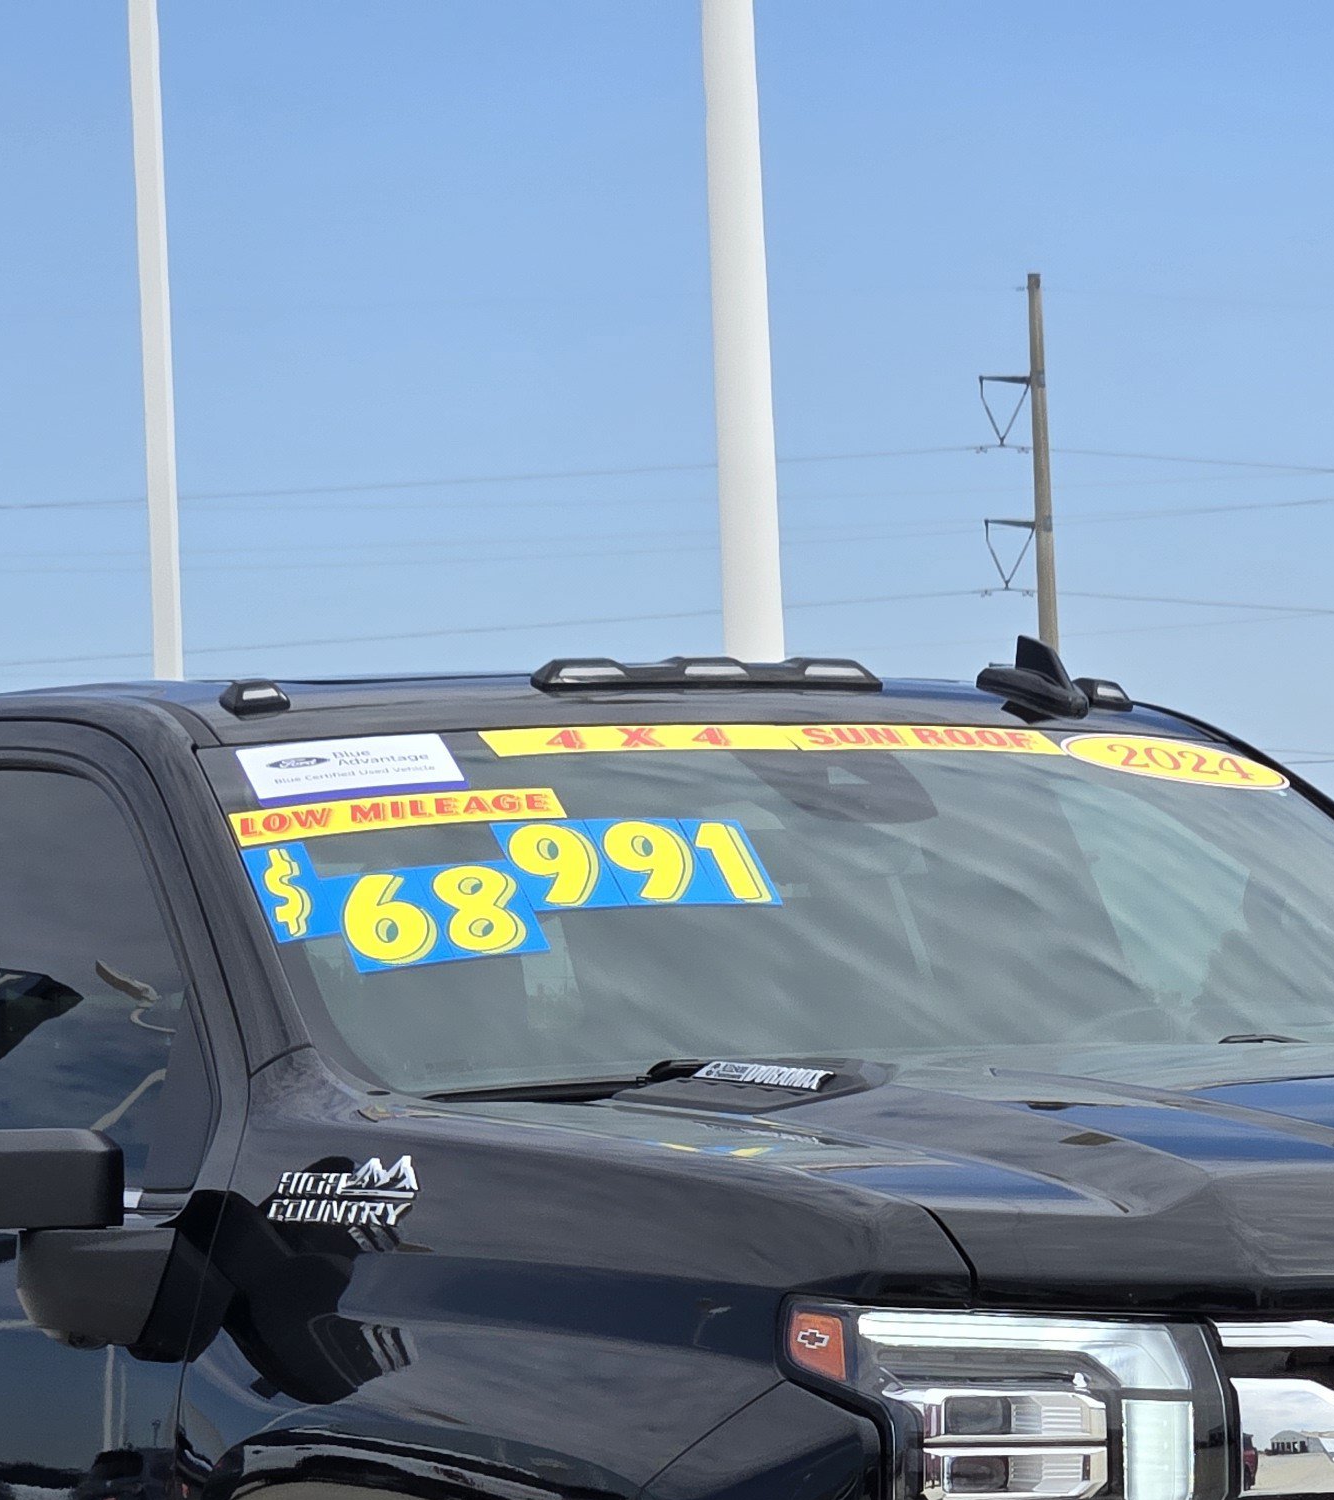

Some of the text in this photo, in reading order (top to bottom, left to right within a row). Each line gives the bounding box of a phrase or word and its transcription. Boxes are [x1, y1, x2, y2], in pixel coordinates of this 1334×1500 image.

[802, 727, 1039, 752] SUN ROOF
[332, 749, 371, 760] Blue
[338, 752, 430, 768] Advantage
[1106, 742, 1257, 782] 2024
[274, 764, 436, 785] Blue Certified Used Vehicle
[239, 791, 552, 839] LOW MILEAGE
[742, 1064, 833, 1090] DURAMAX
[278, 1171, 353, 1196] HIGH
[267, 1198, 412, 1227] COUNTRY
